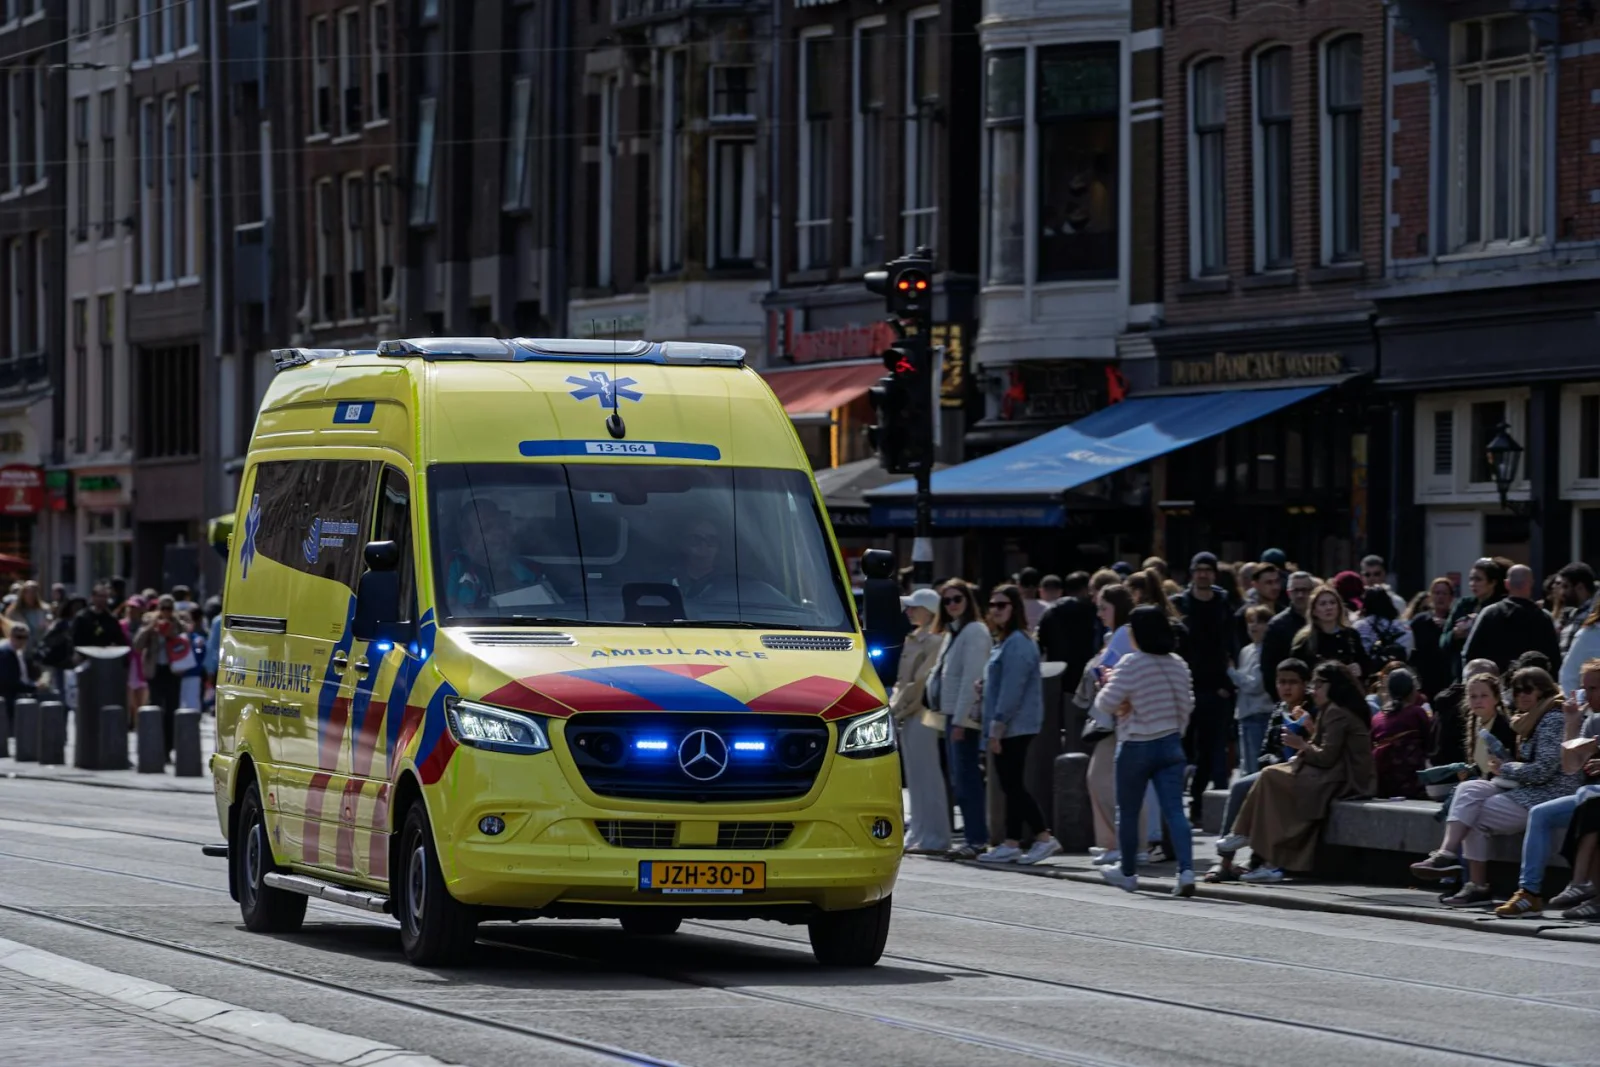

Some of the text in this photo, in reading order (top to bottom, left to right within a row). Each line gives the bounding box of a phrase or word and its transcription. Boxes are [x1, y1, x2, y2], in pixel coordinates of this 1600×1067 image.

[1214, 351, 1281, 381] PANCAKE
[596, 443, 648, 453] 13-164
[591, 648, 769, 660] AMBULANCE
[256, 660, 311, 694] AMBULANCE
[659, 865, 755, 885] JZH-30-D
